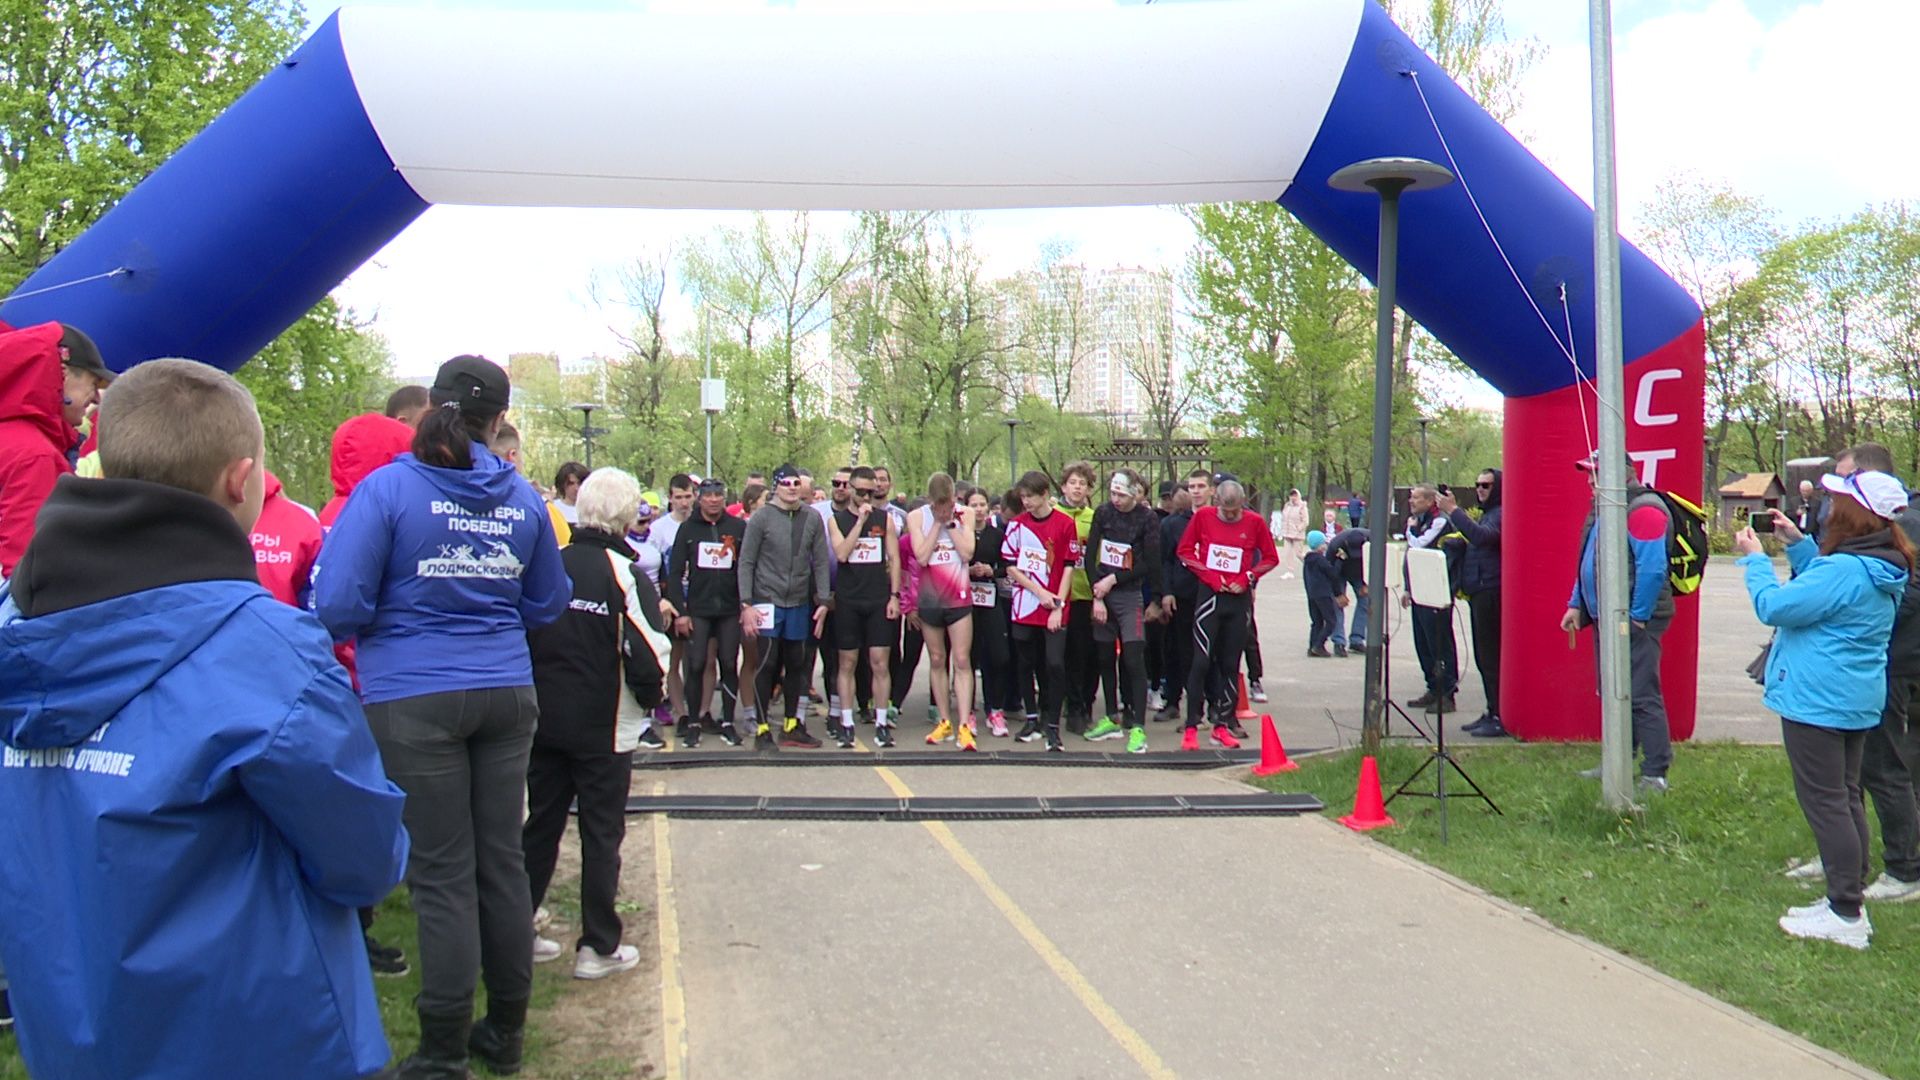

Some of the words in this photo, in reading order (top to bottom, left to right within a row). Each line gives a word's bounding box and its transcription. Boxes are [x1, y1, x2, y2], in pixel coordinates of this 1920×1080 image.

[430, 500, 525, 521] ВОЛЕРЫ
[448, 517, 512, 536] ПОБЕДЫ
[248, 533, 281, 547] РЫ
[711, 556, 719, 566] 8
[857, 550, 870, 561] 47
[937, 551, 951, 562] 49
[1109, 554, 1120, 565] 10
[427, 563, 519, 576] ПОДМОСКОВЬЕ
[1027, 560, 1040, 571] 23
[1216, 559, 1230, 569] 46
[974, 593, 986, 604] 28
[74, 748, 136, 777] ОТЧИЗНЕ
